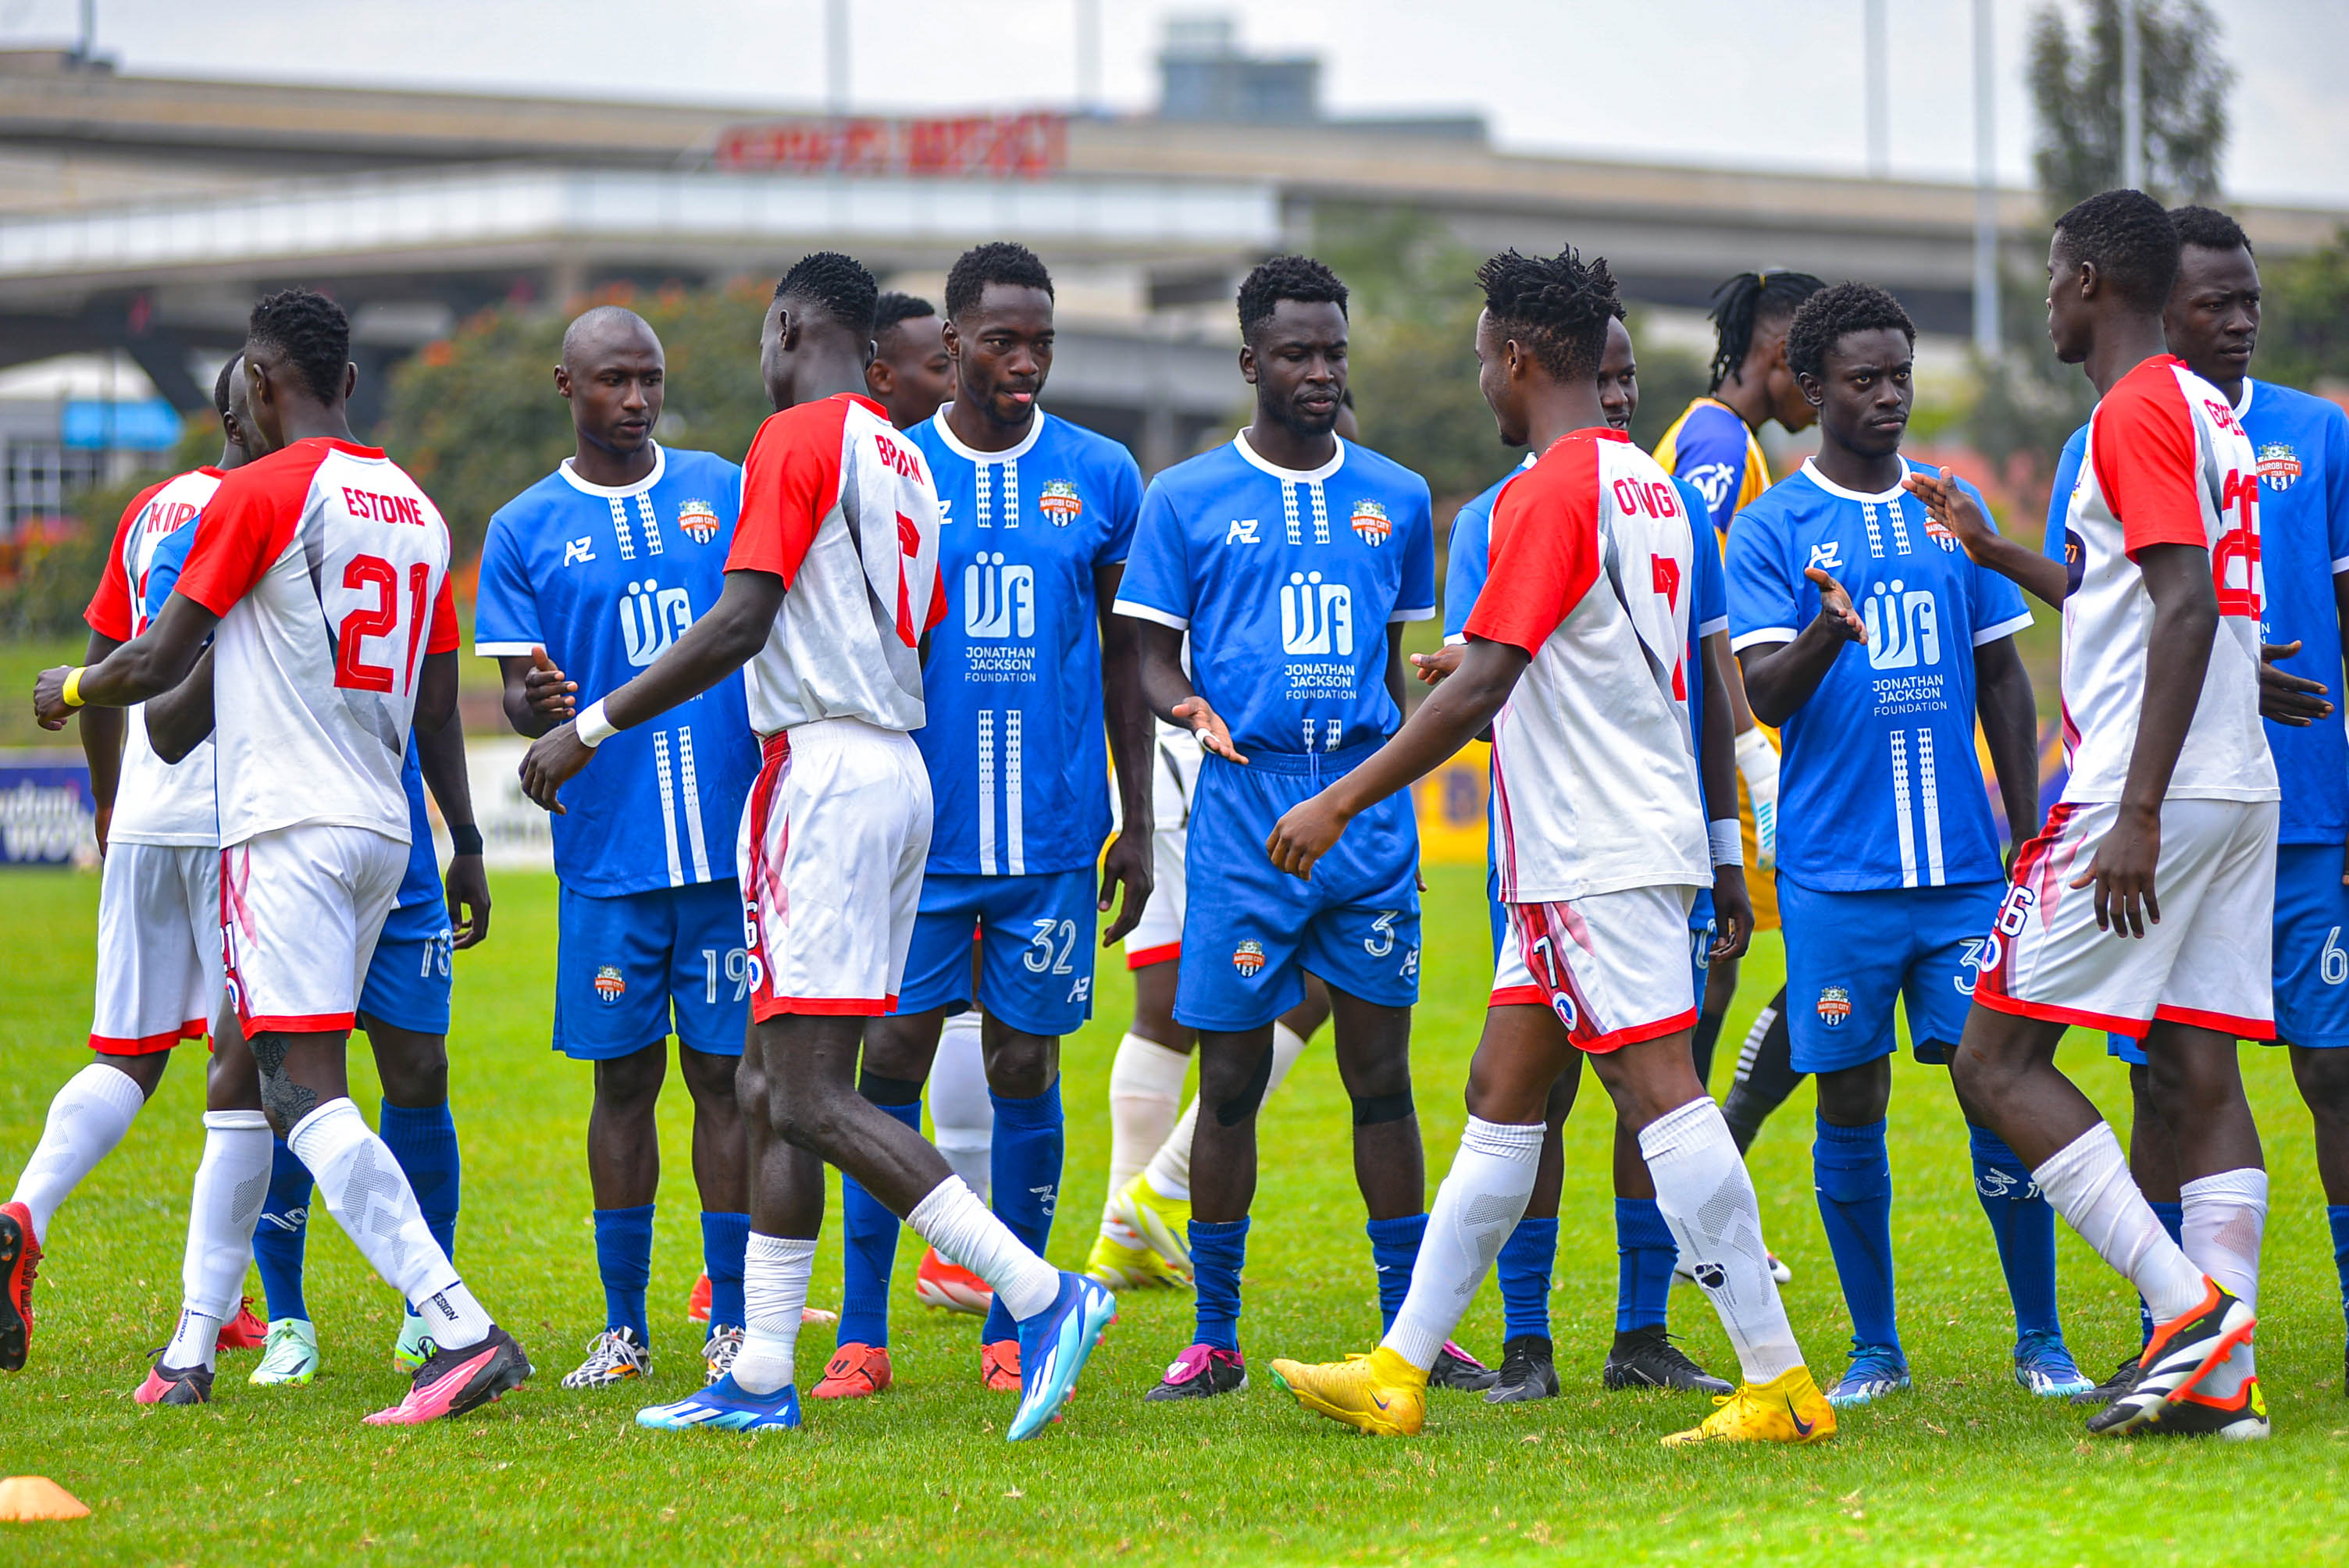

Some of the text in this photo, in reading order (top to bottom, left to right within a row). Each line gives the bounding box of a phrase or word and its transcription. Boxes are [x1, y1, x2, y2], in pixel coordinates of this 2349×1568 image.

[2255, 462, 2298, 472] NAIROBI CITY
[341, 486, 426, 527] ESTONE
[1065, 499, 1079, 511] CITY
[147, 502, 203, 533] KIP
[704, 516, 717, 526] CITY
[1376, 520, 1389, 531] CITY
[334, 554, 430, 697] 21
[965, 647, 1035, 659] JONATHAN
[970, 659, 1031, 671] JACKSON
[1285, 664, 1355, 676] JONATHAN
[964, 672, 1036, 682] FOUNDATION
[1290, 675, 1352, 688] JACKSON
[1872, 674, 1944, 693] JONATHAN
[1285, 689, 1357, 700] FOUNDATION
[1878, 687, 1941, 704] JACKSON
[1873, 701, 1948, 717] FOUNDATION
[1364, 911, 1399, 957] 3
[1024, 918, 1077, 975] 32
[1533, 935, 1559, 989] 7
[2320, 926, 2348, 985] 6
[702, 947, 747, 1004] 19
